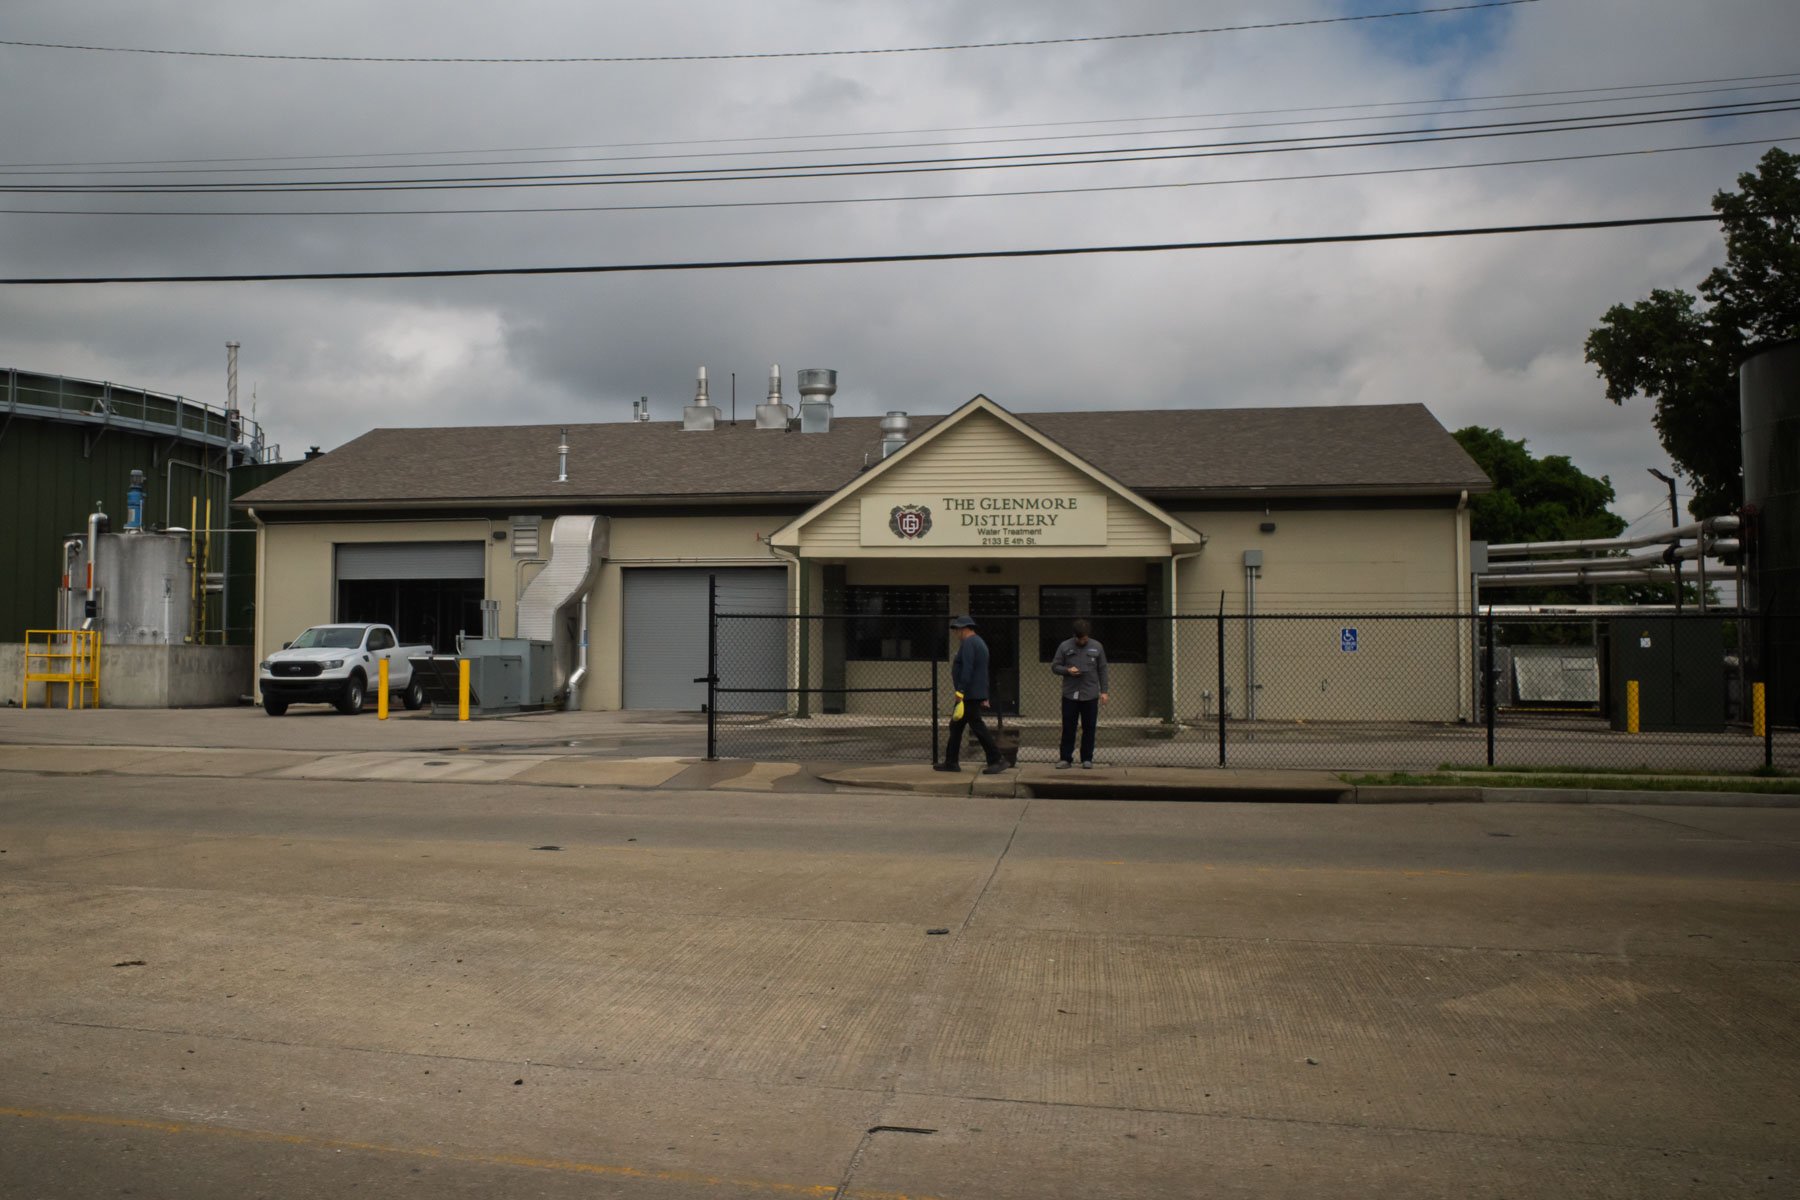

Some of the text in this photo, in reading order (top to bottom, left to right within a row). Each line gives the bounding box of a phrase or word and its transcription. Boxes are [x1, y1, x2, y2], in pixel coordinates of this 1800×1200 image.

[942, 497, 1078, 511] THE GLENMORE
[961, 513, 1059, 526] DISTILLERY
[977, 527, 1043, 536] Water Treatment
[982, 537, 1037, 545] 2133 E 4th St.
